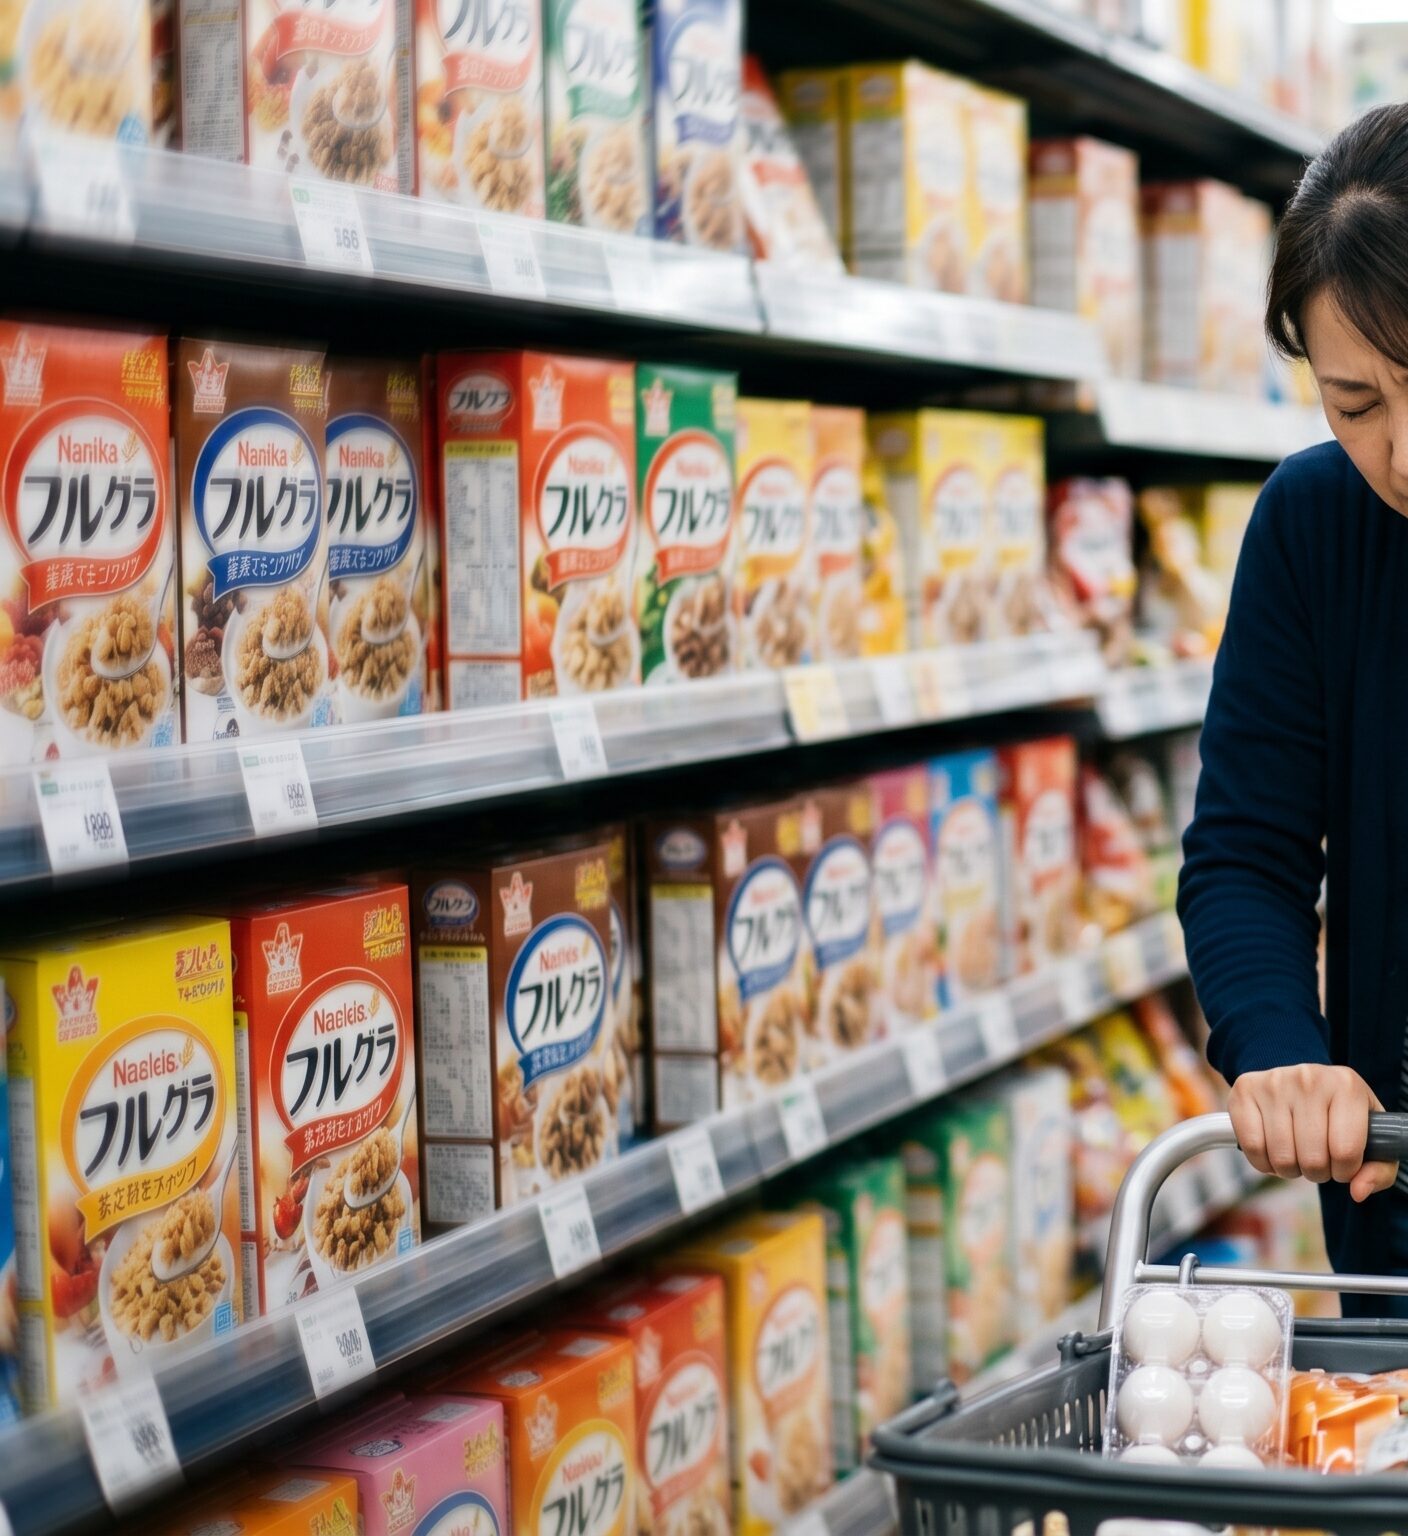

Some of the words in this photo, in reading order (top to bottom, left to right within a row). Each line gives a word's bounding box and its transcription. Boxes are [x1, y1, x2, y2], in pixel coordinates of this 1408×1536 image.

[57, 434, 118, 464] Nanika
[238, 440, 288, 468] Nanika
[339, 444, 385, 469] Nanika
[24, 473, 156, 545] フルグラ
[209, 475, 316, 540] フルグラ
[519, 965, 600, 1041] フルグラ
[286, 1022, 396, 1117] フルグラ
[79, 1073, 215, 1178] フルグラ
